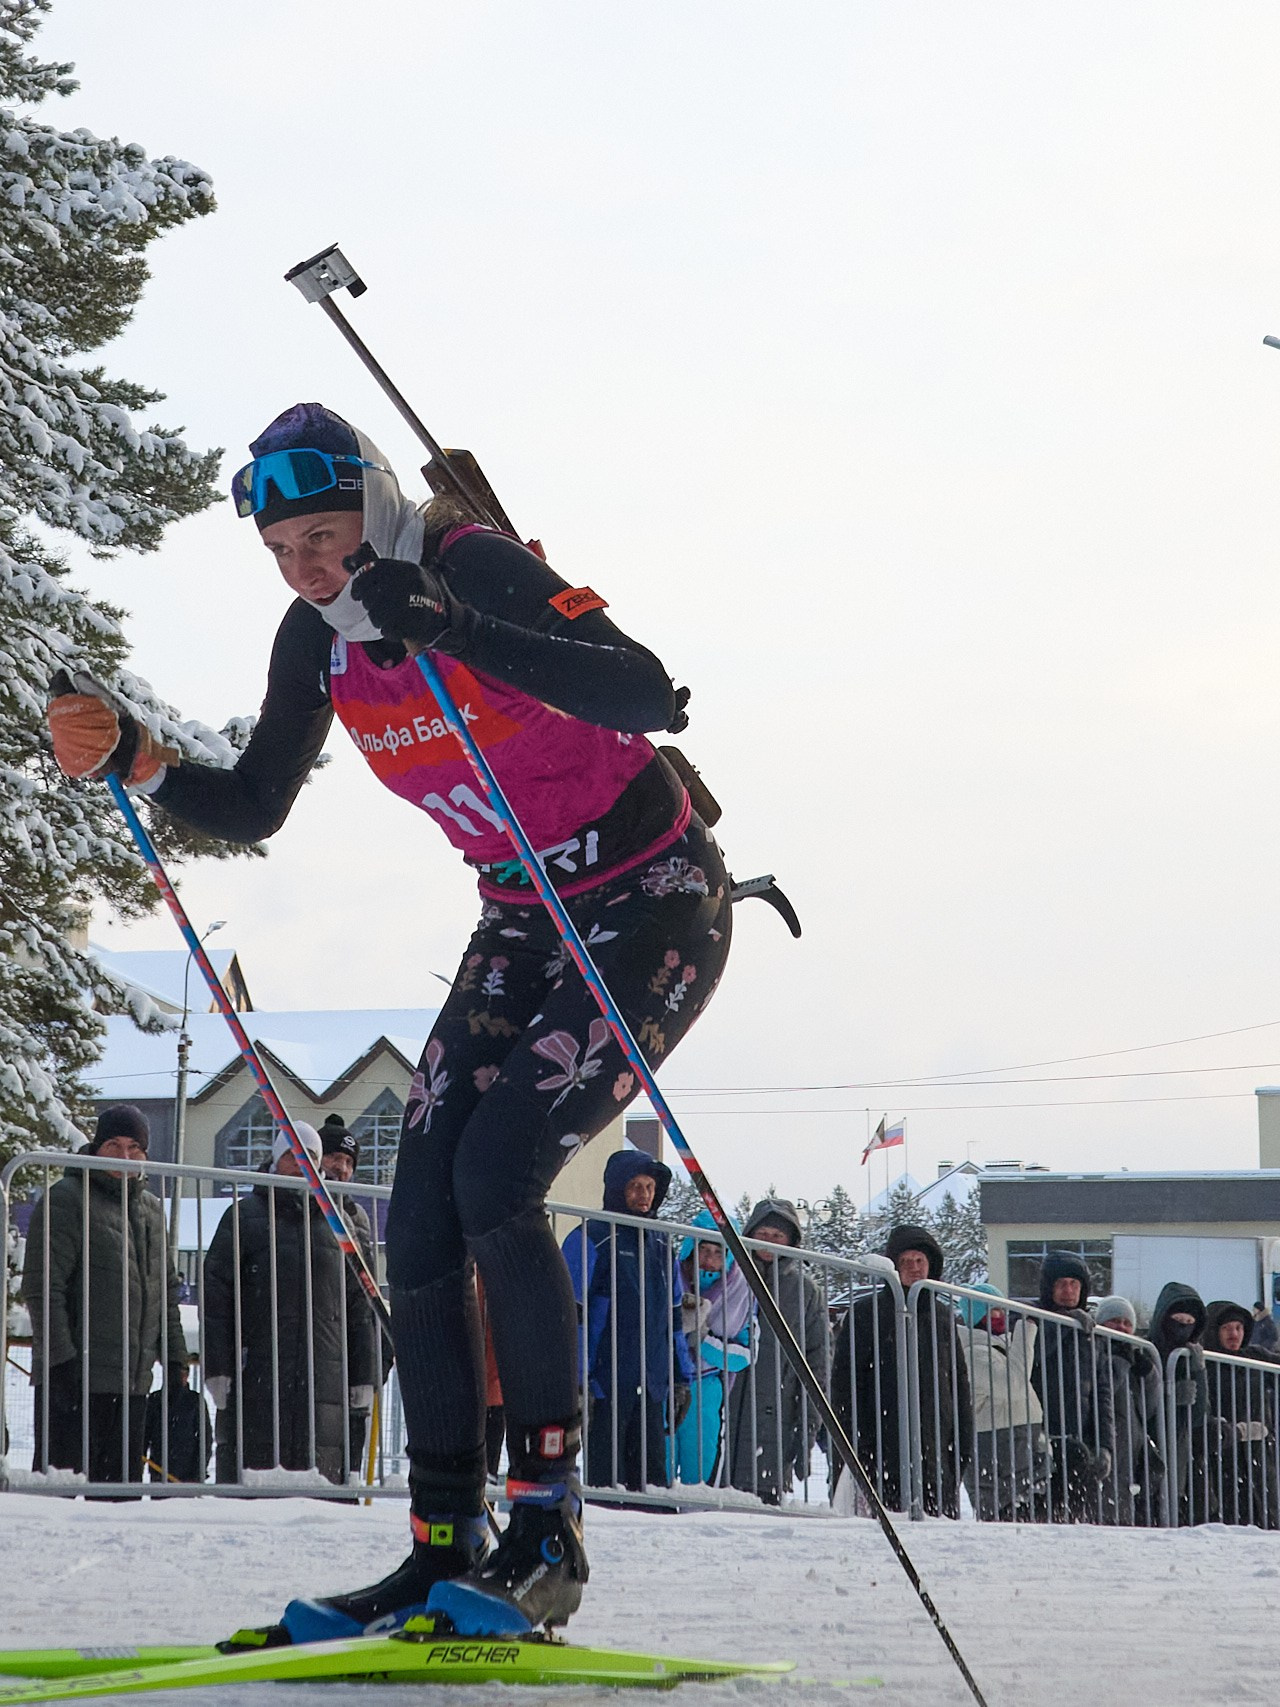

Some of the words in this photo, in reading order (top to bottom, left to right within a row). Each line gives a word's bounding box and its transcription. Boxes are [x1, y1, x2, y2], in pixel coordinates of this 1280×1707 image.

[350, 723, 414, 756] Альфа
[422, 784, 506, 836] 11
[512, 1562, 549, 1601] SALOMON
[426, 1646, 520, 1665] FISCHER
